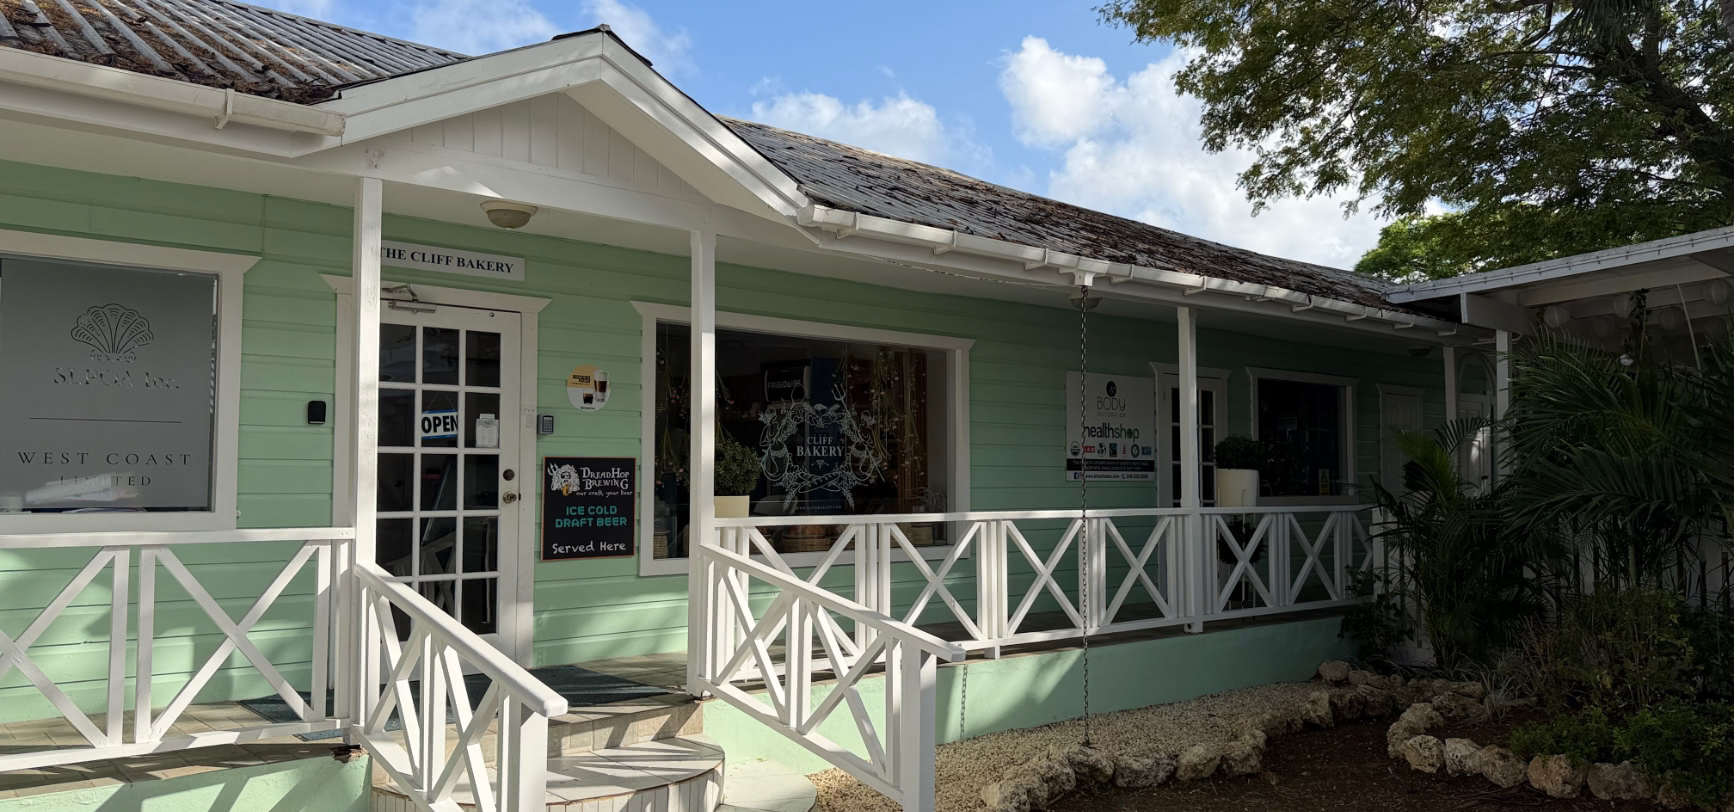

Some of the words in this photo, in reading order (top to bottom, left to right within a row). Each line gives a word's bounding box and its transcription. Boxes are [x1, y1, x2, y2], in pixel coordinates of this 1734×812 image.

[411, 251, 453, 266] CLIFF
[456, 257, 514, 273] BAKERY
[144, 371, 180, 389] Inc.
[421, 415, 458, 434] OPEN
[807, 436, 833, 445] CLIFF
[796, 445, 844, 457] BAKERY
[17, 452, 89, 465] WEST
[106, 453, 191, 465] COAST
[566, 506, 585, 515] ICE
[587, 505, 618, 515] COLD
[555, 518, 594, 528] DRAFT
[596, 517, 627, 527] BEER
[552, 540, 595, 555] Served
[600, 541, 627, 551] Here
